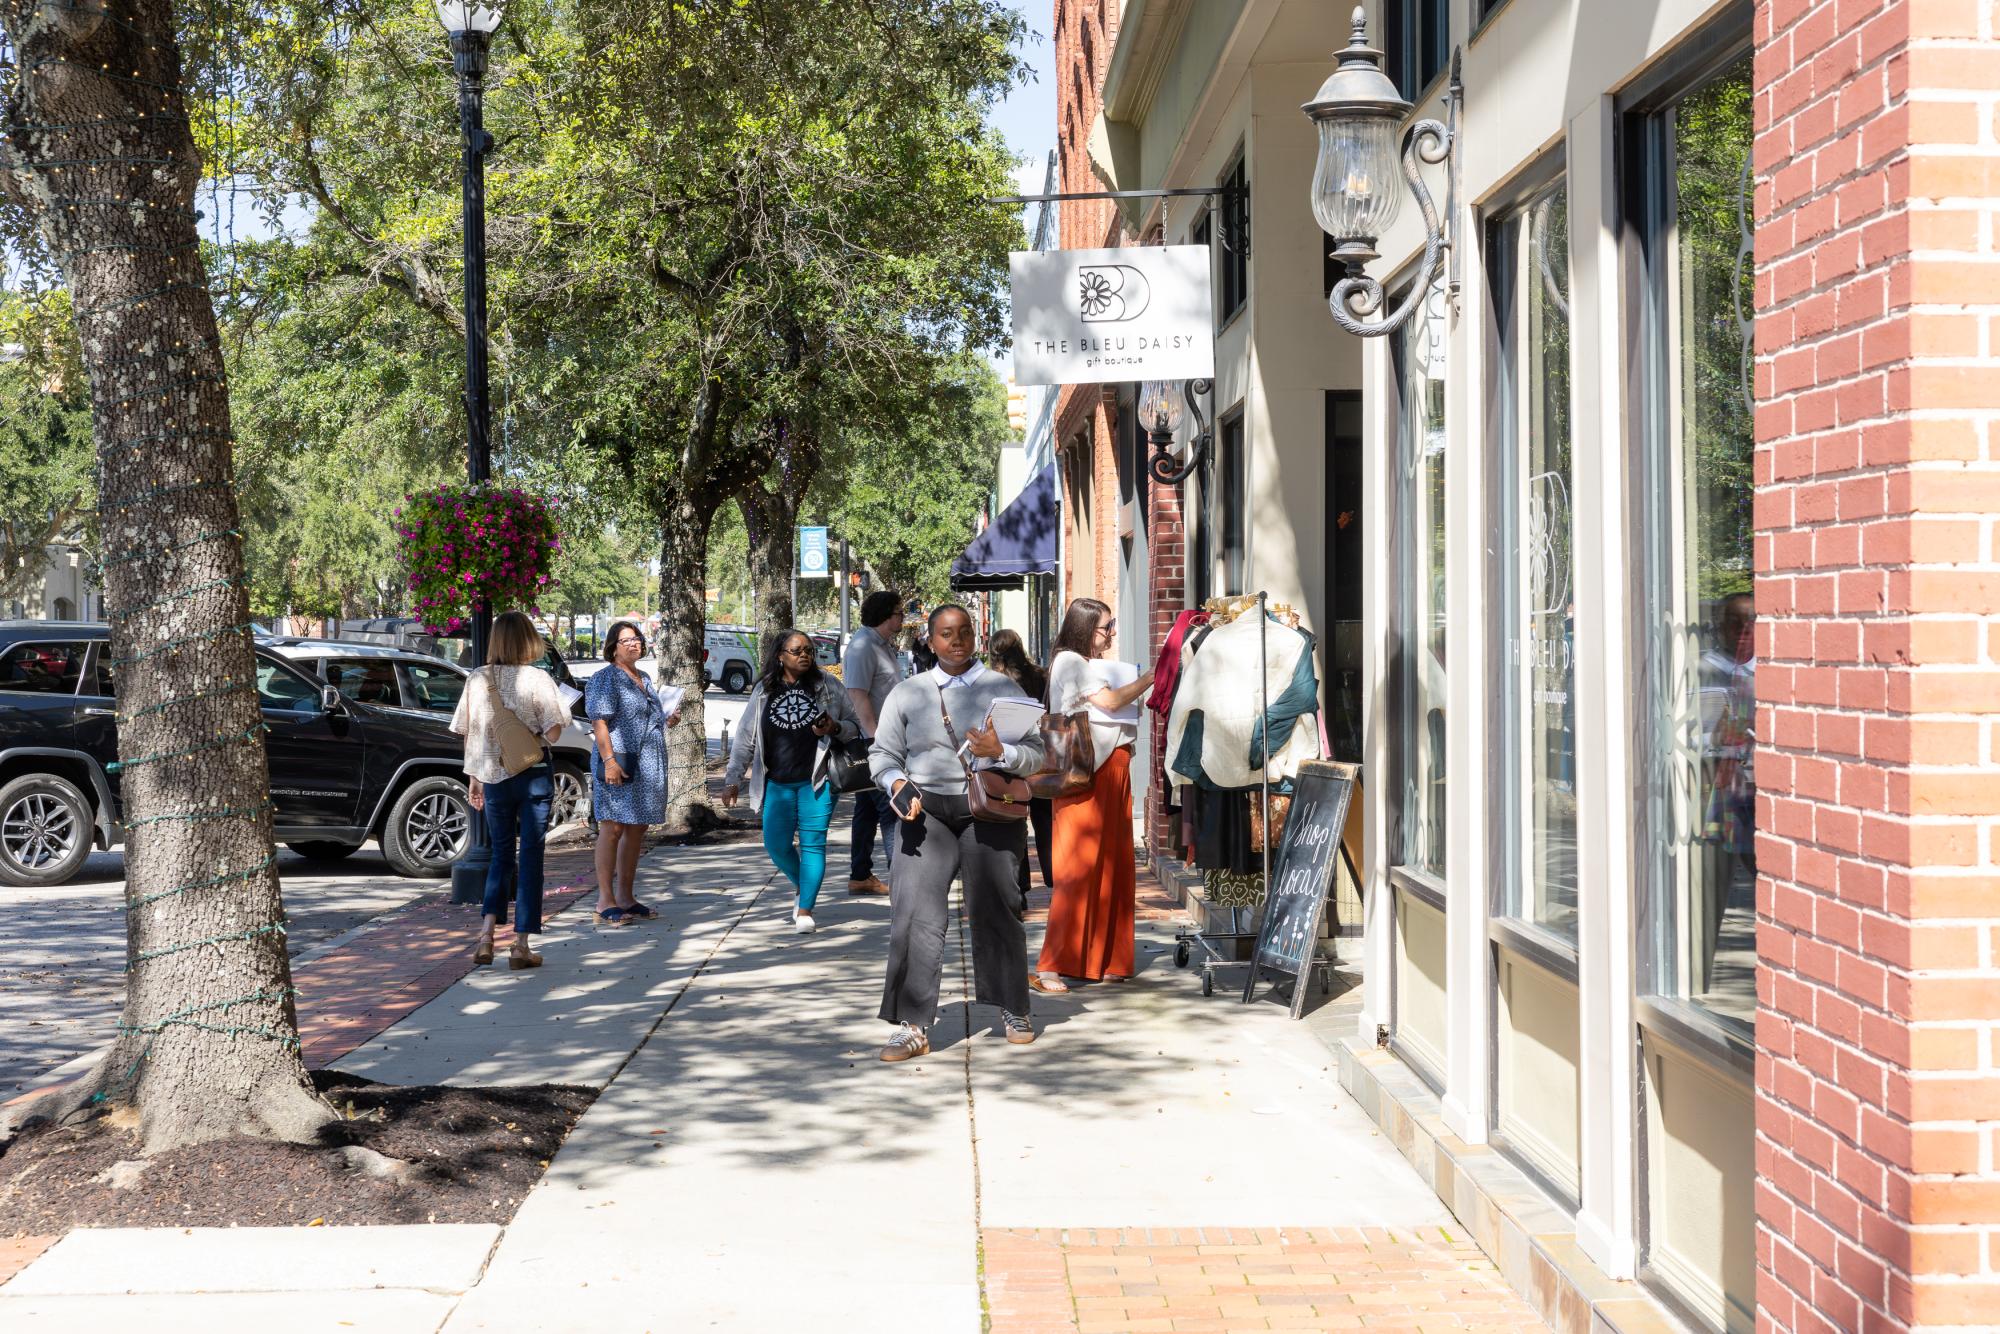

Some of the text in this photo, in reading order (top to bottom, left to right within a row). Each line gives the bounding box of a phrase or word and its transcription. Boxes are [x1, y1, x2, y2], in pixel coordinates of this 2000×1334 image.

[1035, 335, 1193, 354] THE BLEU DAISY
[1086, 356, 1143, 368] gift boutique
[769, 708, 817, 730] MAIN STREET
[1275, 859, 1323, 898] local
